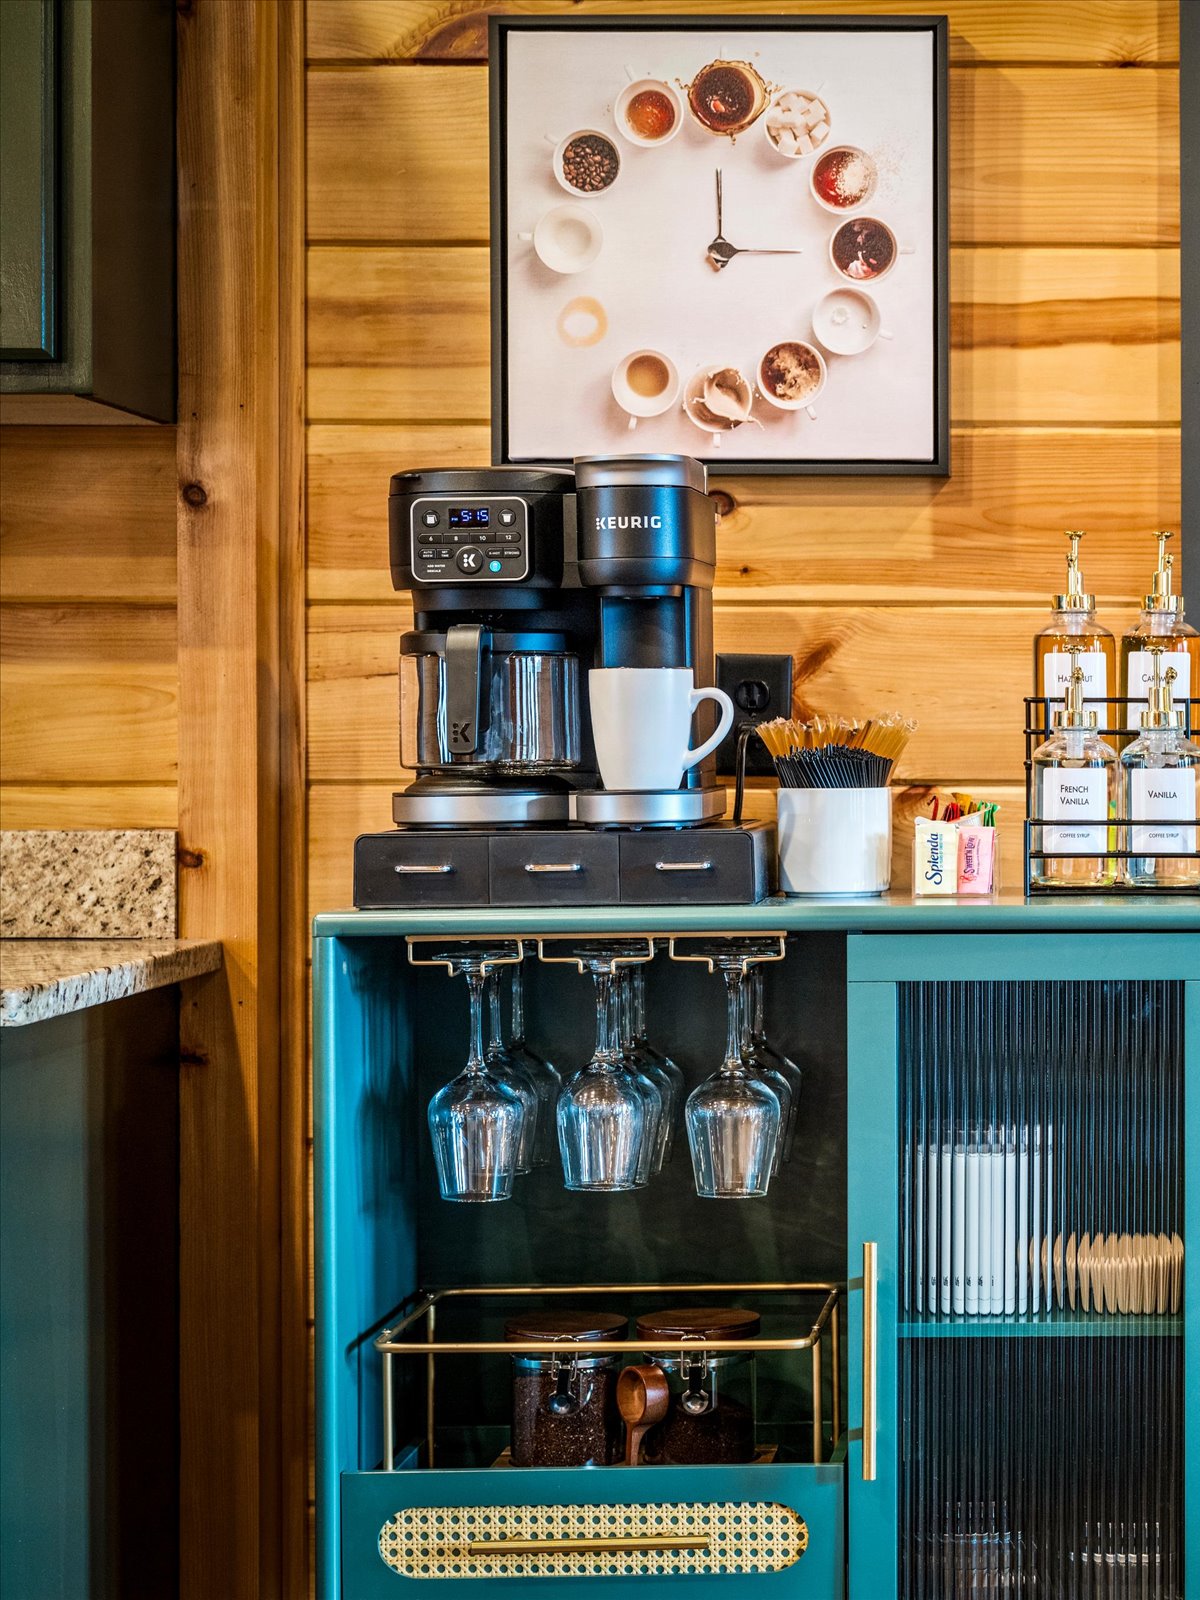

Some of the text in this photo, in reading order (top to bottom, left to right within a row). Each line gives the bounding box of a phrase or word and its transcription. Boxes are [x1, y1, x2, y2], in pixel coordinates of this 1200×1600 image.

[461, 510, 489, 522] 5:15
[595, 515, 662, 530] KEURIG
[1060, 784, 1089, 793] FRENCH
[1147, 790, 1177, 799] VANILLA
[1060, 797, 1089, 806] VANILLA
[924, 832, 943, 885] Splenda
